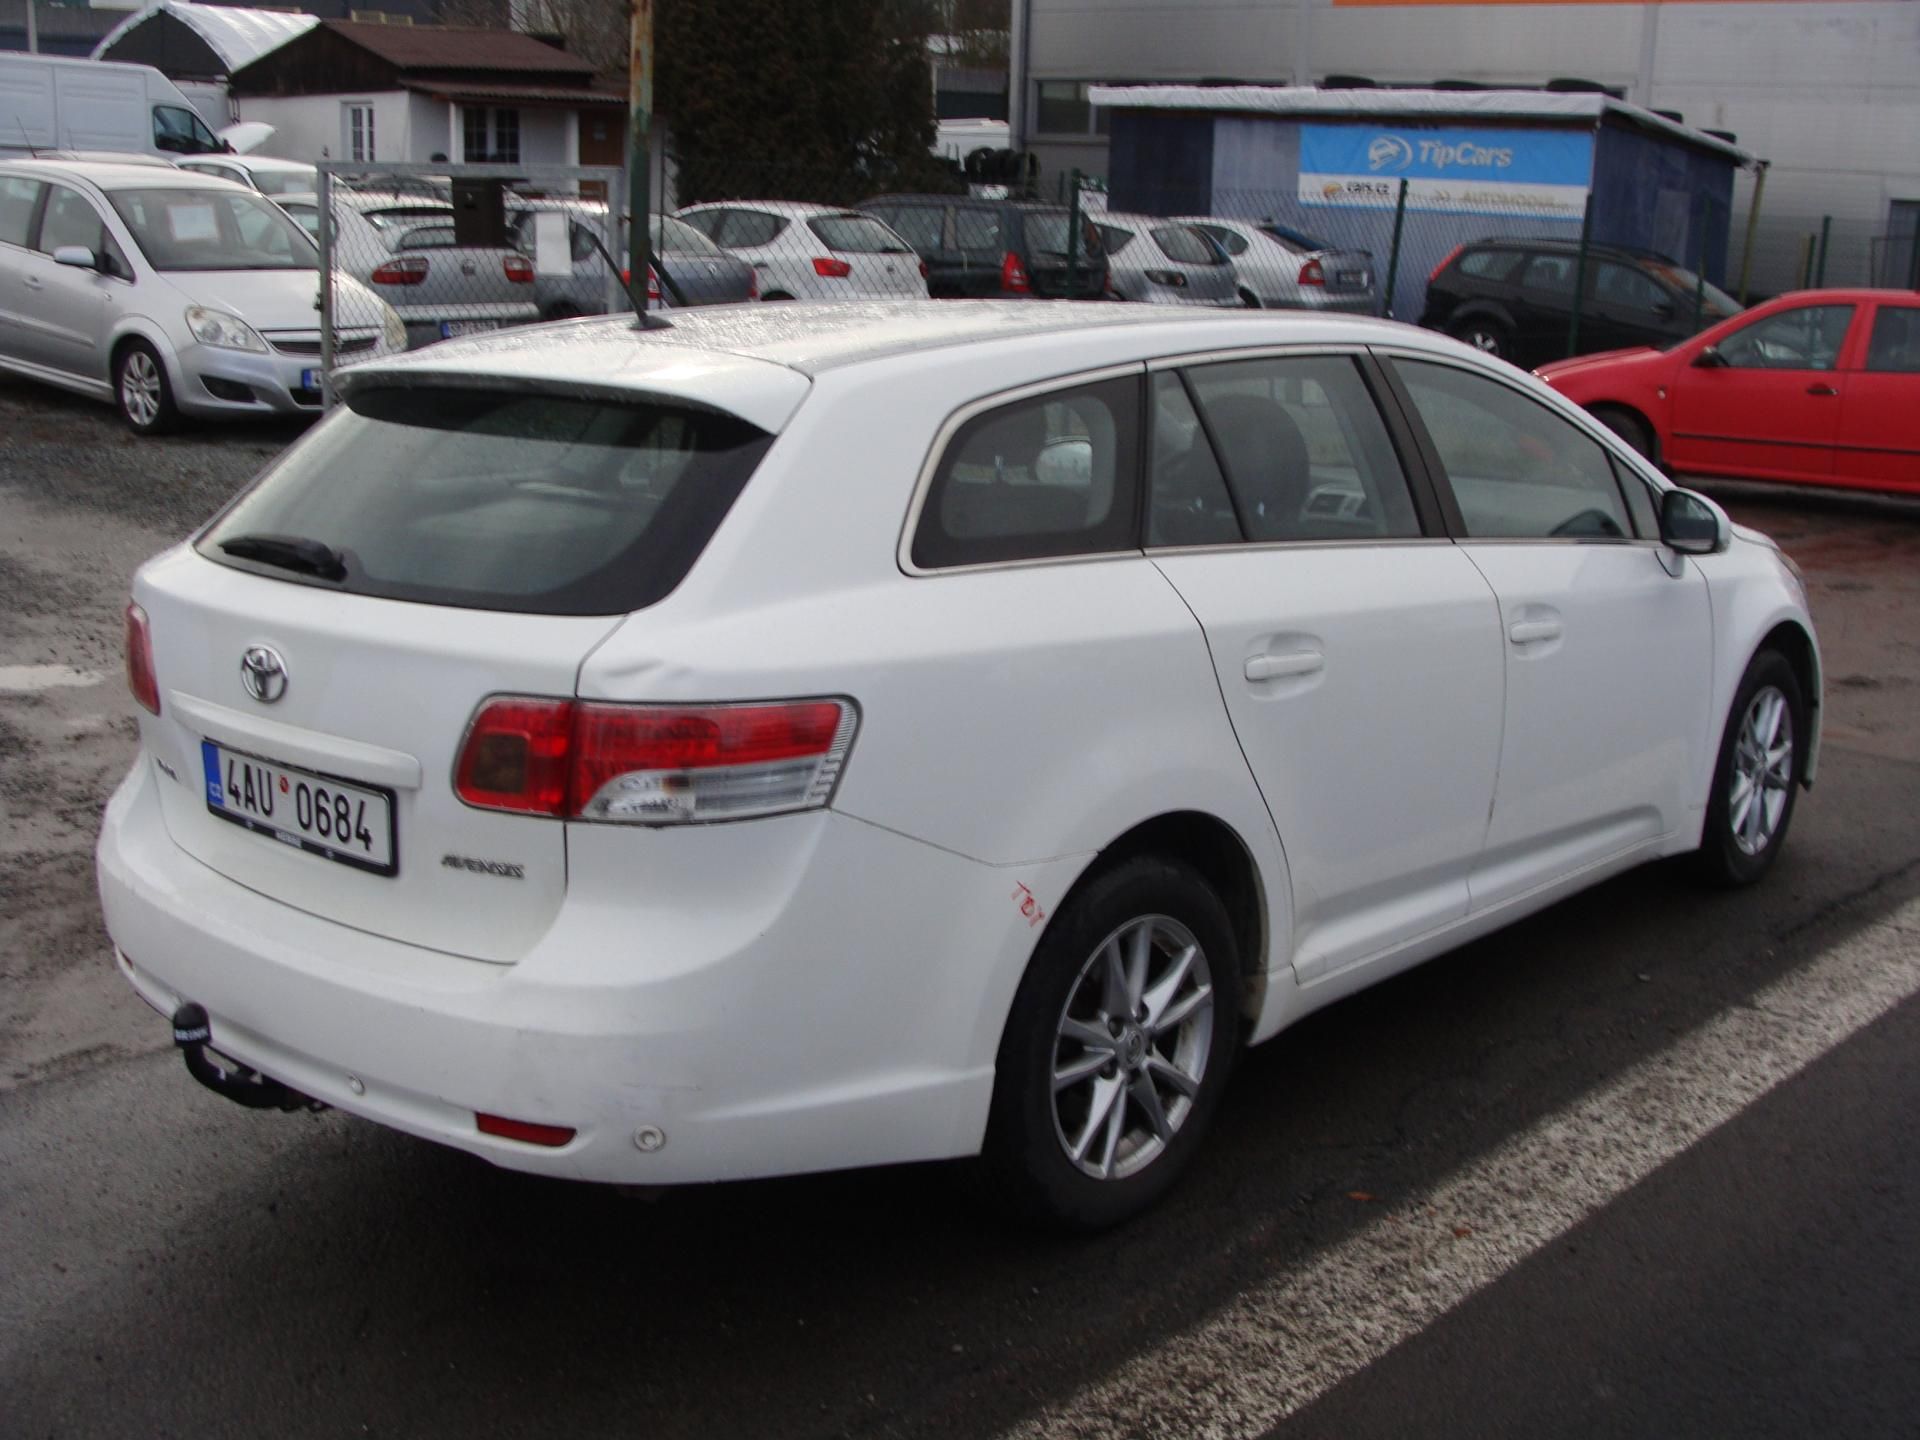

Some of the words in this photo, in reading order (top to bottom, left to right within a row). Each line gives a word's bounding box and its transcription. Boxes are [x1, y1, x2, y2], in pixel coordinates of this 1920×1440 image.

[1418, 139, 1513, 168] TipCars
[227, 759, 273, 817] 4AU
[296, 782, 372, 851] 0684
